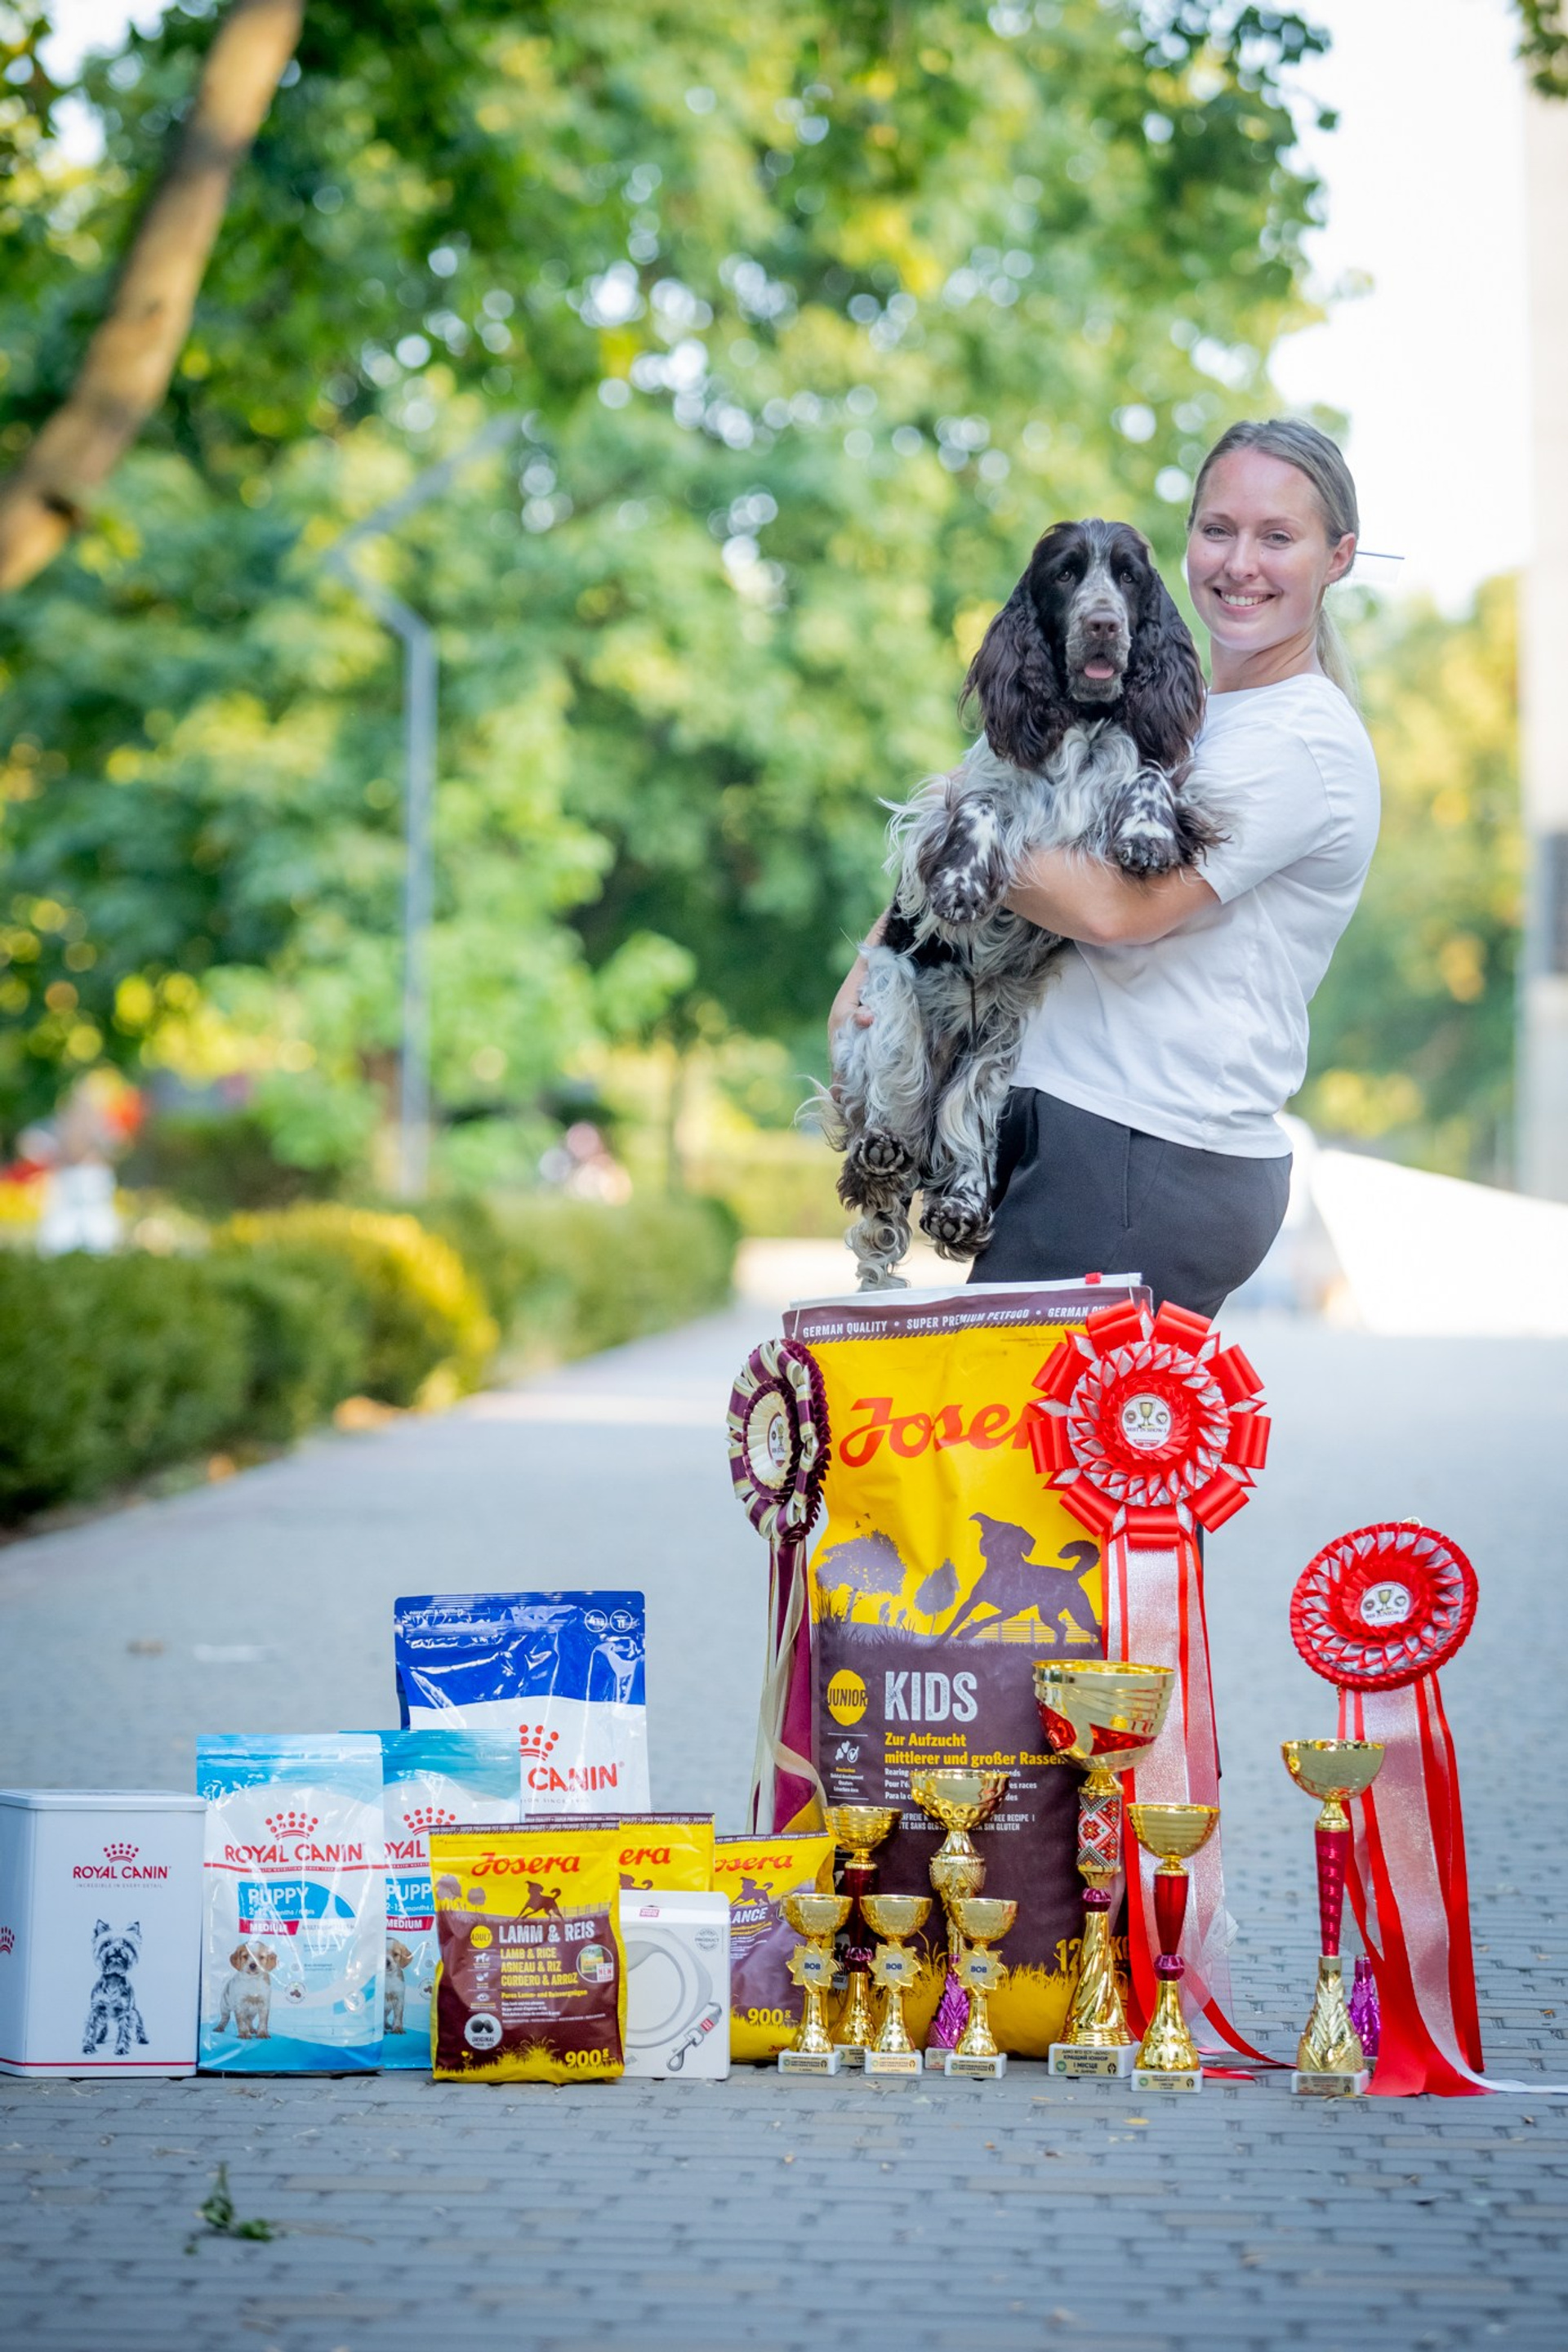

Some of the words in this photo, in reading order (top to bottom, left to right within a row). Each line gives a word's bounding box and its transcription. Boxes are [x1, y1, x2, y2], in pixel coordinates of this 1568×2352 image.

[803, 1323, 843, 1338] GERMAN
[847, 1321, 887, 1334] QUALITY
[906, 1316, 939, 1330] SUPER
[942, 1312, 985, 1327] PREMIUM
[1048, 1306, 1089, 1318] GERMAN
[839, 1396, 1036, 1468] Joser
[827, 1687, 869, 1707] JUNIOR
[884, 1671, 978, 1722] KIDS
[884, 1732, 906, 1747] Zur
[908, 1732, 967, 1748] Aufzucht
[884, 1751, 940, 1765] mittlerer
[943, 1753, 967, 1765] und
[971, 1752, 1016, 1768] großer
[527, 1762, 618, 1793] CANIN
[884, 1767, 910, 1778] Rearing
[884, 1780, 900, 1788] Pour
[884, 1791, 899, 1800] Para
[1007, 1813, 1029, 1823] RECIPE
[910, 1821, 926, 1830] SANS
[996, 1822, 1020, 1831] GLUTEN
[225, 1844, 289, 1864] ROYAL
[294, 1842, 363, 1863] CANIN
[618, 1846, 671, 1866] era
[73, 1865, 118, 1879] ROYAL
[121, 1865, 168, 1879] CANIN
[471, 1852, 581, 1877] Josera
[248, 1886, 310, 1905] PUPPY
[386, 1882, 432, 1901] PUPP
[405, 1903, 430, 1912] months
[732, 1906, 768, 1924] ANCE
[250, 1922, 288, 1936] MEDIUM
[387, 1918, 423, 1929] MEDIUM
[470, 1932, 492, 1942] ADULT
[498, 1925, 544, 1944] LAMM
[547, 1923, 561, 1943] &
[564, 1920, 595, 1942] REIS
[500, 1948, 525, 1960] LAMB
[527, 1948, 536, 1959] &
[537, 1947, 557, 1959] RICE
[501, 1961, 536, 1973] AGNEAU
[537, 1961, 546, 1972] &
[546, 1960, 562, 1972] RIZ
[970, 1965, 987, 1973] BOB
[501, 1974, 541, 1987] CORDERO
[542, 1974, 550, 1986] &
[550, 1972, 578, 1985] ARROZ
